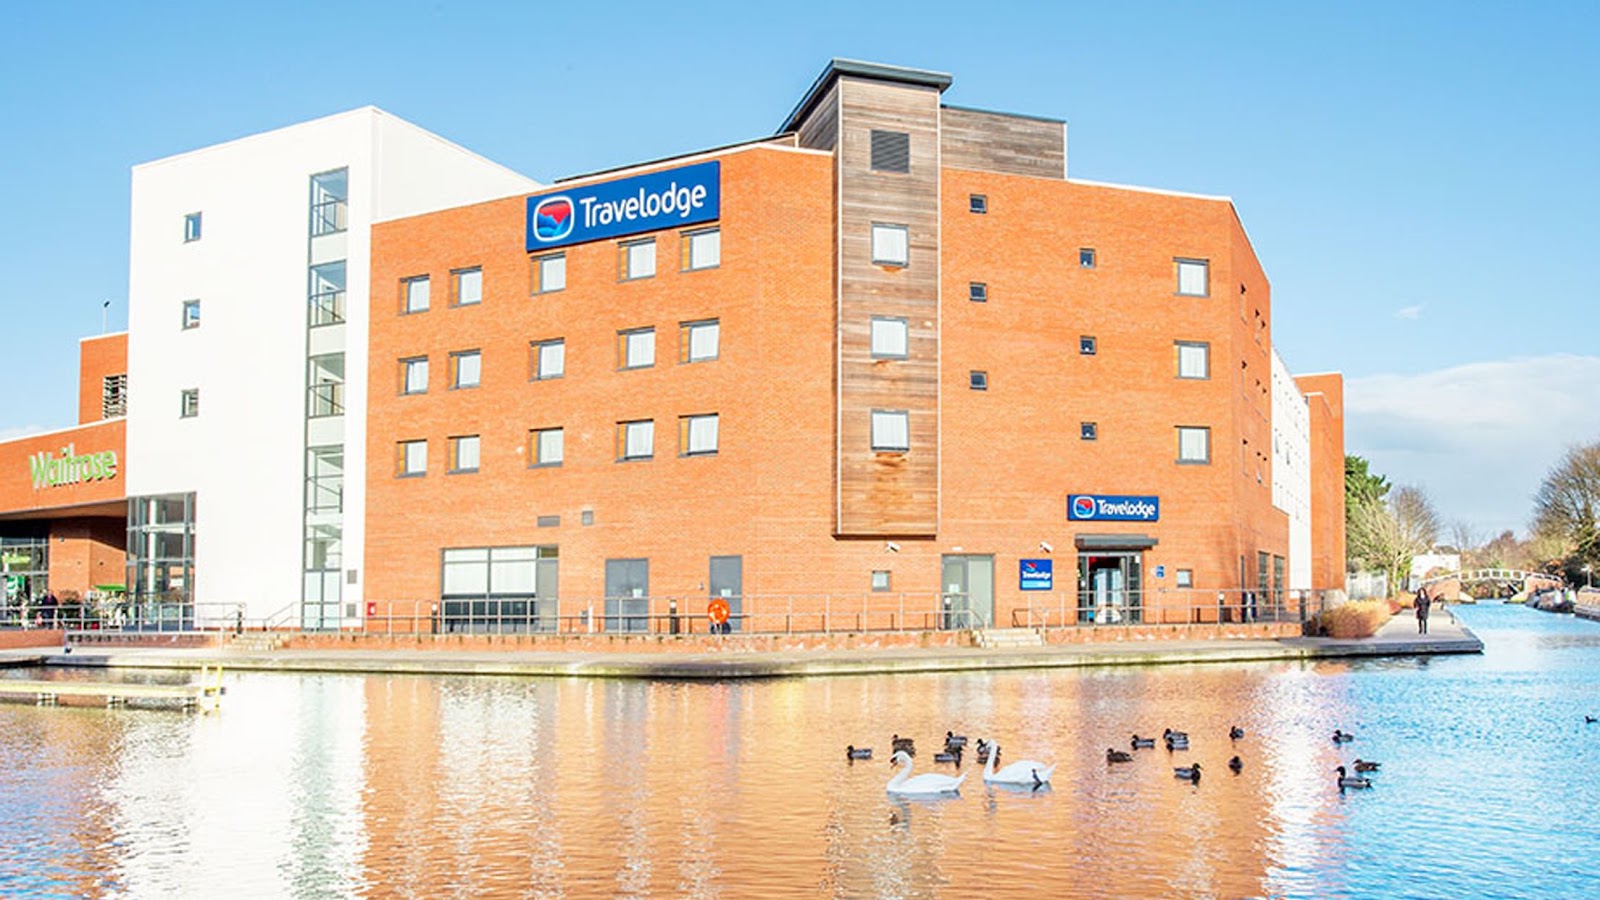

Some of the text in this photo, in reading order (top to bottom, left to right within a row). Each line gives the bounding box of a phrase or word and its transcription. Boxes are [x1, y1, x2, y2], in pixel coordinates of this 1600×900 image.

[579, 182, 707, 229] Travelodge
[29, 442, 117, 489] Waitrose
[1097, 500, 1155, 518] Travelodge
